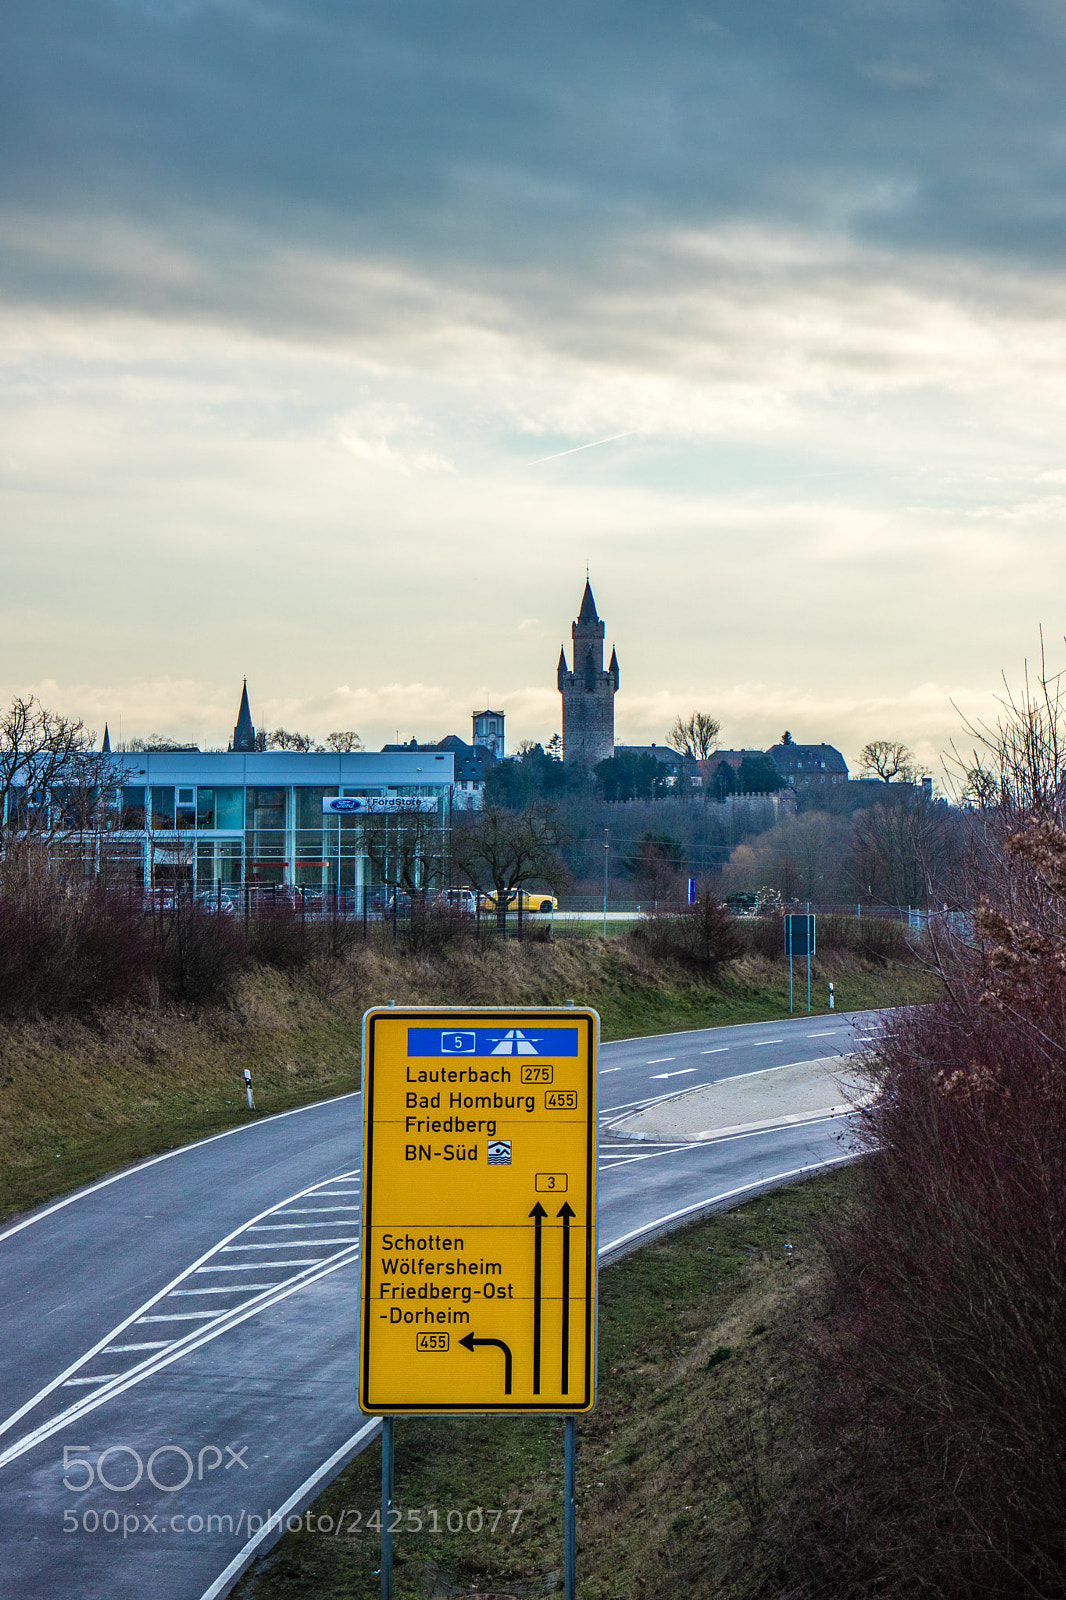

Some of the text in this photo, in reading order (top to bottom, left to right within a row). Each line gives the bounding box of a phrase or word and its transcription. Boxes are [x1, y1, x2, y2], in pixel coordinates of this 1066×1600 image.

[336, 798, 422, 809] Ford FordStore
[454, 1036, 462, 1049] 5
[406, 1067, 550, 1083] Lauterbach 275
[406, 1092, 574, 1113] Bad Homburg 455
[405, 1117, 497, 1137] Friedberg
[405, 1144, 478, 1161] BN-Süd
[547, 1176, 556, 1189] 3
[382, 1234, 464, 1250] Schotten
[382, 1258, 502, 1275] Wölfersheim
[379, 1282, 514, 1303] Friedberg-Ost
[379, 1306, 470, 1324] -Dorheim
[420, 1335, 446, 1349] 455
